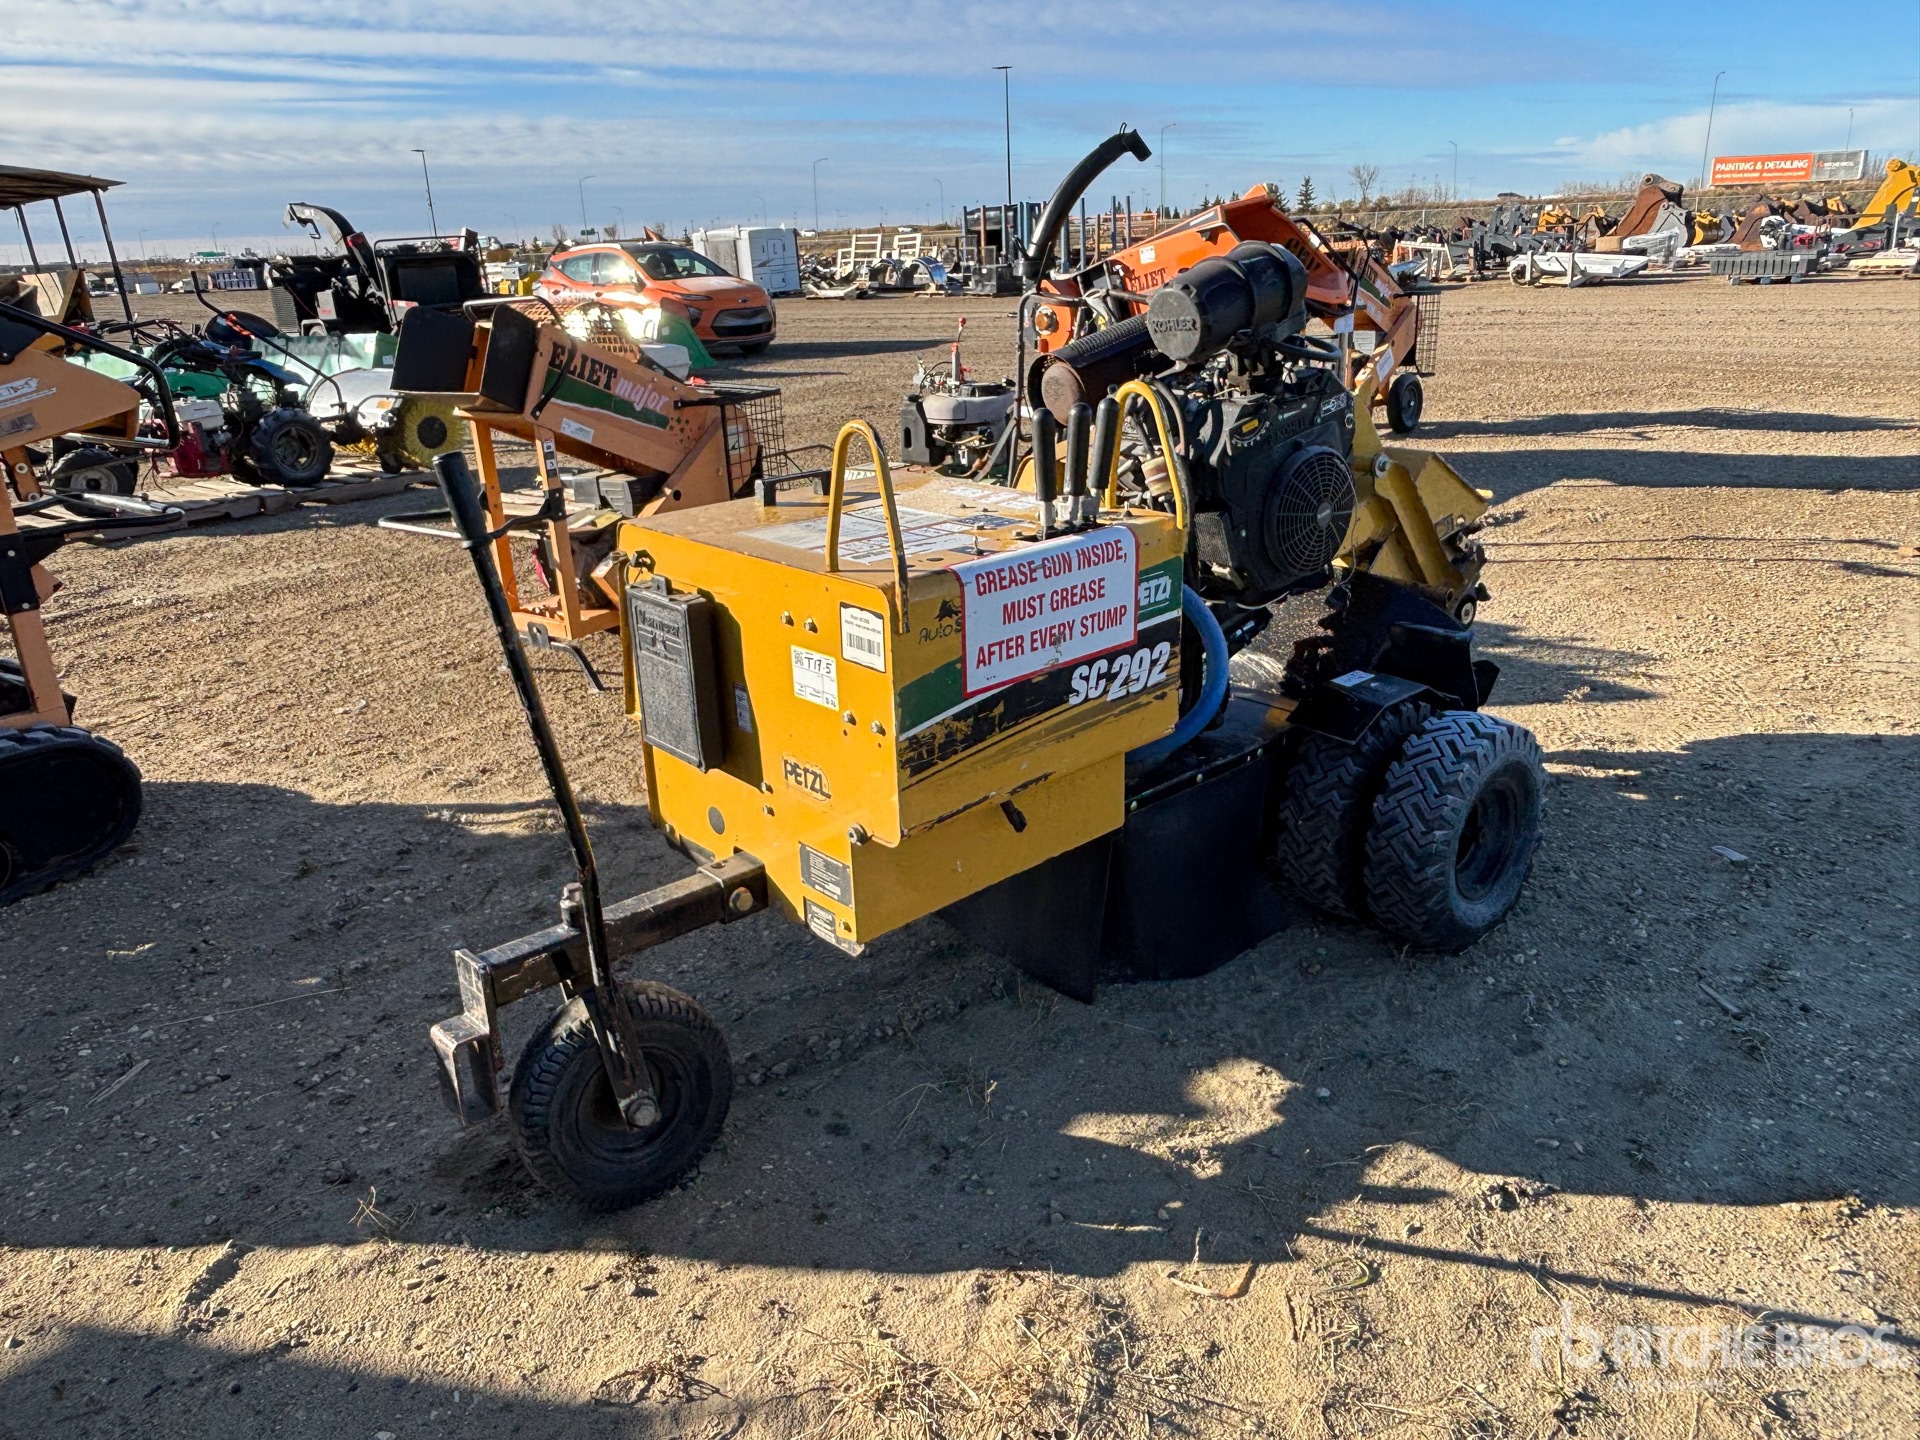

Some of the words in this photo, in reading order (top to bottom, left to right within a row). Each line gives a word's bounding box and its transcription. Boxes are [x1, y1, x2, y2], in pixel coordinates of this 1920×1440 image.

[1715, 162, 1754, 172] PAINTING
[1755, 161, 1763, 170] &
[1763, 159, 1809, 170] DETAILING
[1130, 267, 1166, 293] ELIET
[1152, 319, 1198, 334] KOHLER
[549, 341, 618, 392] ELIET
[614, 377, 670, 411] major
[975, 560, 1037, 597] GREASE
[1042, 552, 1073, 579] GUN
[1076, 538, 1128, 570] INSIDE,
[1002, 593, 1045, 626] MUST
[1049, 577, 1106, 611] GREASE
[975, 640, 1025, 670] AFTER
[1030, 621, 1076, 652] EVERY
[1080, 604, 1128, 637] STUMP
[1068, 641, 1171, 705] SC292
[783, 758, 832, 799] PETZL
